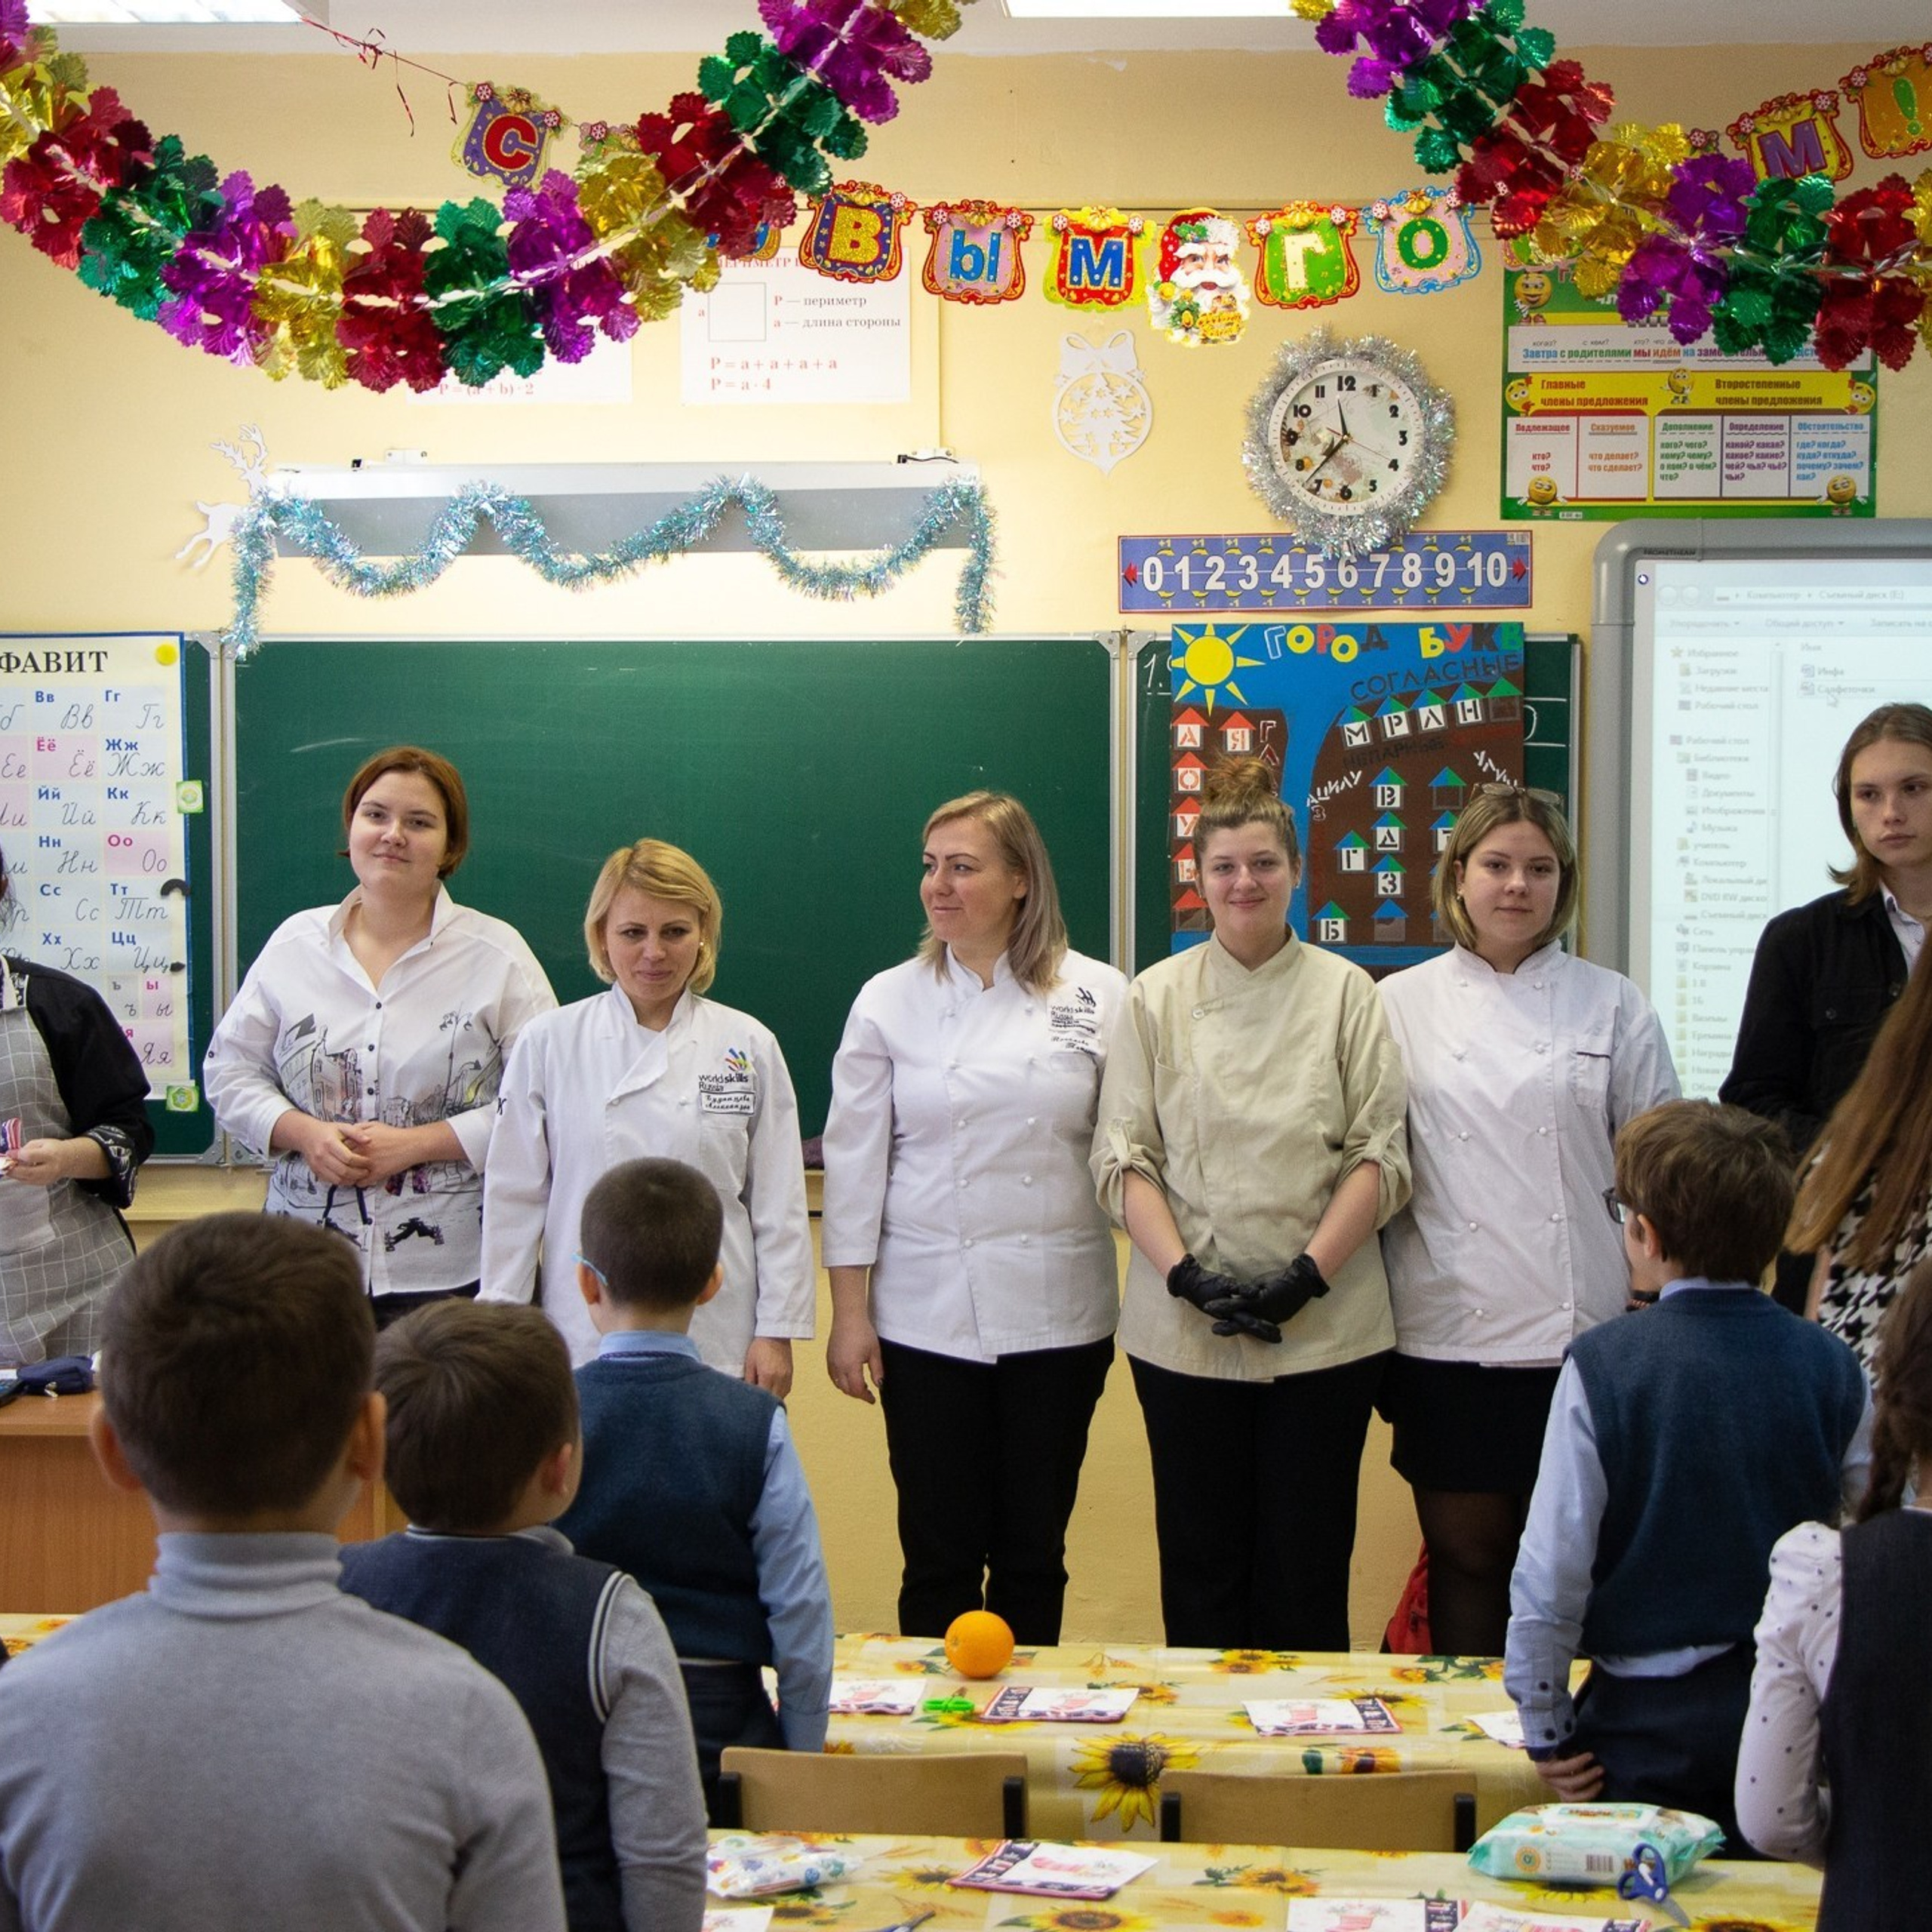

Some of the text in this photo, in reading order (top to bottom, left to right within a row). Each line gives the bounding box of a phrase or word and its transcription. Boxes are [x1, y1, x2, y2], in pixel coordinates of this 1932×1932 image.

[483, 113, 537, 171] С
[804, 296, 867, 308] периметр
[802, 318, 901, 329] длина стороны
[1522, 348, 1558, 359] Завтра
[1560, 350, 1566, 358] с
[1567, 349, 1632, 360] родителями
[1633, 349, 1651, 358] мы
[1653, 346, 1681, 358] идём
[1683, 349, 1695, 358] на
[1337, 376, 1356, 391] 12
[1541, 380, 1585, 389] Главные
[1715, 379, 1801, 389] Второстепенные
[1315, 386, 1324, 398] 11
[1540, 396, 1648, 408] члены предложения
[1715, 396, 1823, 407] члены предложения
[1294, 405, 1312, 417] 10
[1389, 405, 1398, 417] 2
[1515, 423, 1570, 432] Подлежащее
[1591, 423, 1635, 432] Сказуемое
[1662, 423, 1713, 431] Дополнение
[1729, 423, 1784, 431] Определение
[1286, 429, 1298, 442] 9
[1399, 431, 1407, 446] 3
[1532, 452, 1551, 460] кто?
[1604, 452, 1639, 461] делает?
[1296, 460, 1305, 472] 8
[1388, 460, 1398, 471] 4
[1532, 463, 1551, 472] что?
[1603, 463, 1642, 472] сделает?
[1312, 479, 1322, 492] 7
[1369, 480, 1377, 492] 5
[1340, 485, 1352, 500] 6
[1143, 552, 1508, 592] 0 1 2 3 4 5 6 7 8 9 10
[1264, 623, 1524, 663] ГОРОД БУКВ
[0, 651, 108, 673] ФАВИТ
[1351, 654, 1519, 701] СОГЛАСНЫЕ
[35, 691, 55, 703] Вв
[105, 690, 121, 702] Гг
[1462, 700, 1479, 721] Н
[1424, 708, 1443, 728] Л
[1388, 714, 1403, 738] Р
[1180, 727, 1198, 746] А
[1231, 729, 1245, 749] Я
[1346, 721, 1368, 746] М
[36, 737, 56, 752] Ёё
[106, 739, 138, 751] Жж
[1179, 770, 1200, 789] О
[38, 787, 61, 800] Йй
[107, 788, 129, 800] Кк
[1381, 786, 1395, 806] В
[1180, 816, 1198, 835] У
[39, 835, 61, 848] Нн
[108, 835, 133, 847] Оо
[1378, 829, 1398, 848] Д
[57, 851, 98, 874] Нн
[142, 849, 167, 872] Оо
[1346, 849, 1358, 869] Г
[110, 883, 128, 896] Тт
[1381, 873, 1397, 893] З
[40, 884, 61, 896] Сс
[1325, 920, 1340, 940] Б
[42, 933, 62, 945] Хх
[112, 932, 136, 945] Цц
